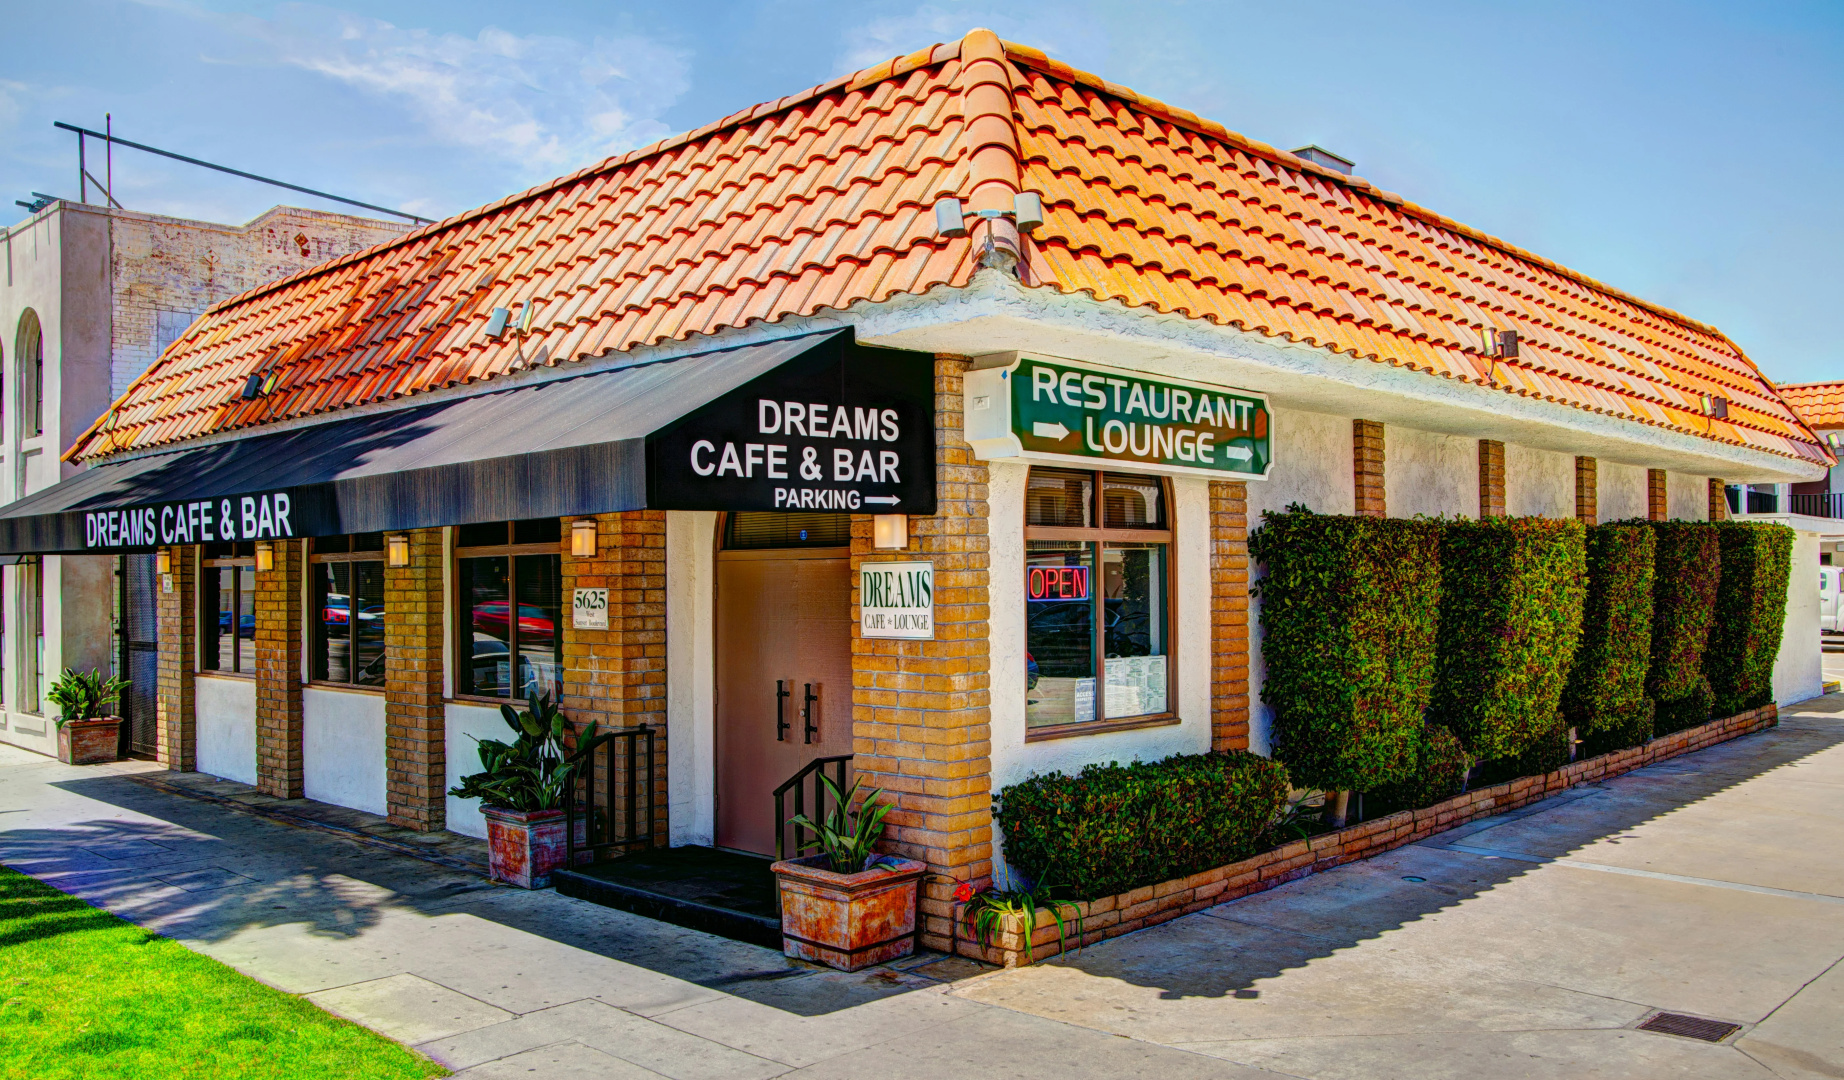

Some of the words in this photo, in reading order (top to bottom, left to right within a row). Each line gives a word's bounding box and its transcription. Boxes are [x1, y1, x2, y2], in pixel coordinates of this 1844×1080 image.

[1032, 365, 1254, 431] RESTAURANT
[758, 399, 900, 442] DREAMS
[1086, 416, 1215, 464] LOUNGE
[690, 439, 789, 479] CAFE
[799, 446, 823, 482] &
[833, 448, 901, 484] BAR
[774, 487, 861, 510] PARKING
[86, 507, 157, 548] DREAMS
[160, 500, 214, 544] CAFE
[219, 498, 236, 541] &
[241, 492, 293, 539] BAR
[575, 590, 606, 610] 5625
[862, 570, 931, 609] DREAMS
[1030, 568, 1087, 598] OPEN
[864, 613, 886, 630] CAFE
[894, 613, 929, 631] LOUNGE
